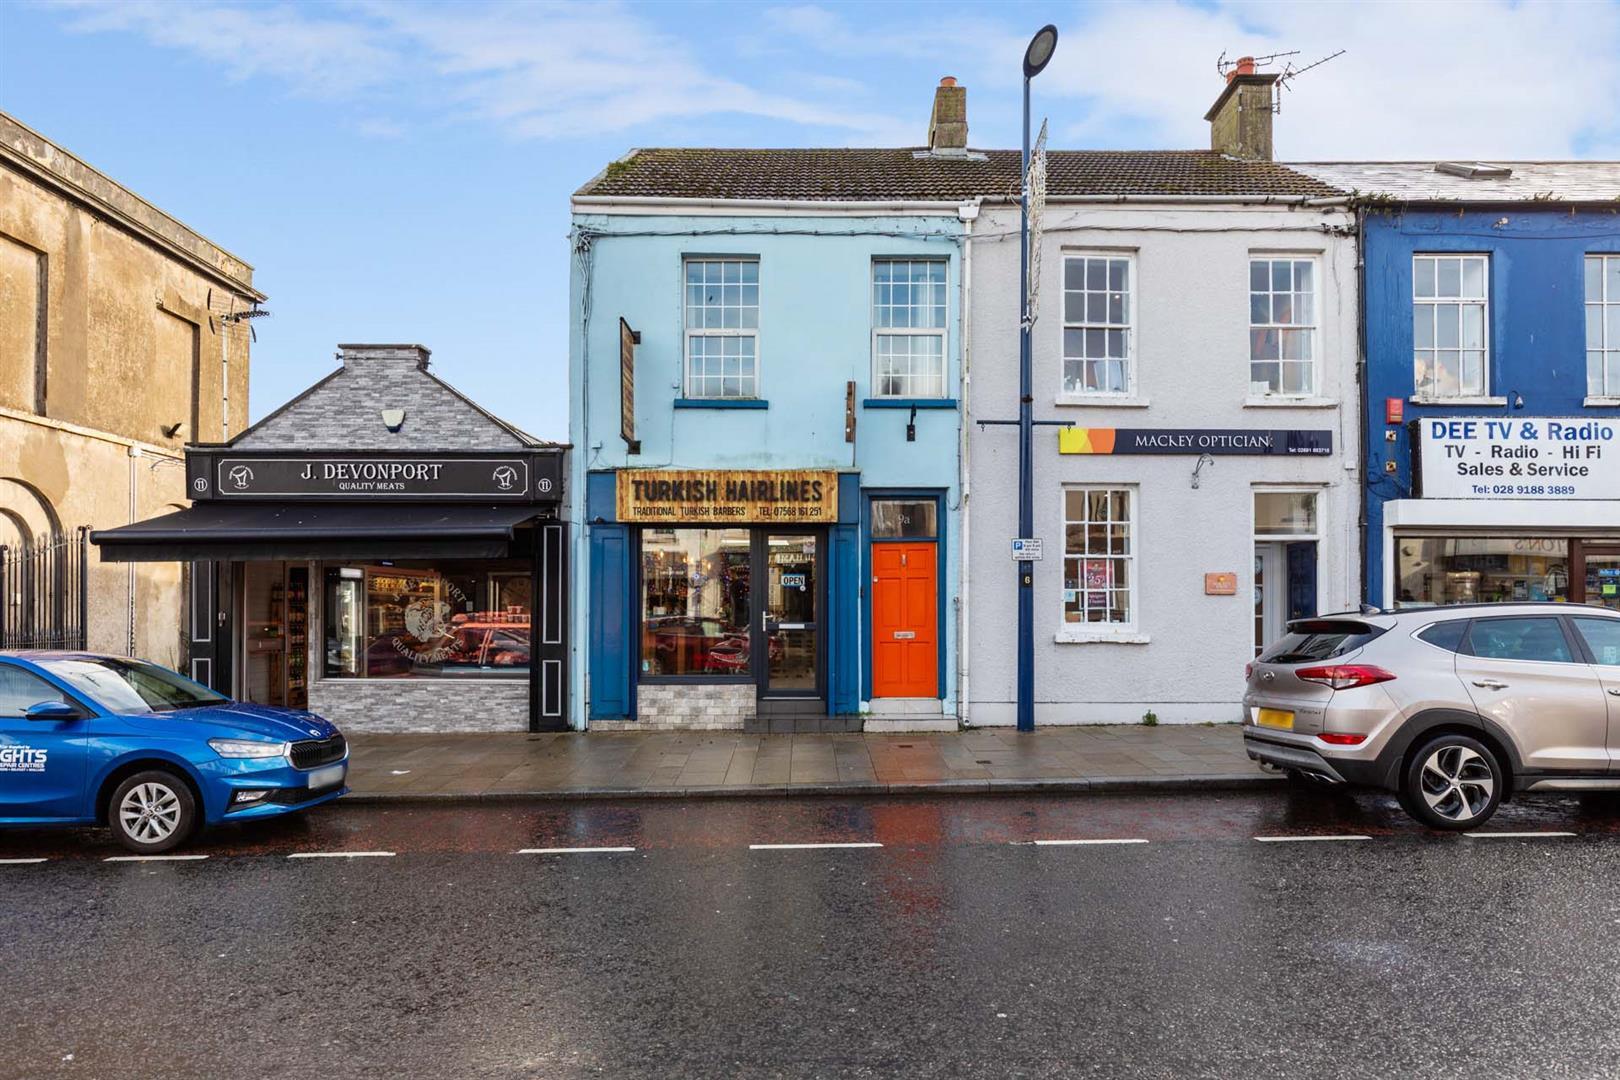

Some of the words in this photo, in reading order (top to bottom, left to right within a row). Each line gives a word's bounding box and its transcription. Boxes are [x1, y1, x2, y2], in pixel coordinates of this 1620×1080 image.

[1431, 422, 1477, 440] DEE
[1484, 422, 1512, 440] TV
[1520, 422, 1538, 440] &
[1547, 422, 1614, 441] Radio
[1135, 435, 1194, 447] MACKEY
[1444, 444, 1466, 458] TV
[1491, 444, 1539, 459] Radio
[1562, 445, 1580, 459] Hi
[1586, 445, 1601, 459] Fi
[300, 463, 318, 480] J.
[324, 463, 443, 481] DEVONPORT
[1457, 462, 1504, 476] Sales
[1509, 463, 1523, 476] &
[1527, 462, 1589, 477] Service
[339, 481, 376, 490] QUALITY
[376, 482, 405, 490] MEATS
[631, 479, 718, 502] TURKISH
[725, 479, 823, 502] HAIRLINES
[1472, 485, 1490, 494] Tel:
[1493, 485, 1514, 495] 028
[1517, 485, 1544, 495] 9188
[1547, 485, 1575, 495] 3889
[632, 507, 676, 516] TRADITIONAL
[681, 507, 710, 516] TURKISH
[713, 507, 746, 516] BARBERS
[809, 507, 822, 516] 251
[898, 513, 911, 525] 9a
[783, 576, 804, 585] OPEN
[1024, 576, 1031, 584] 6
[392, 637, 432, 664] QUALITY
[429, 638, 464, 664] MEATS
[0, 749, 48, 763] GHTS
